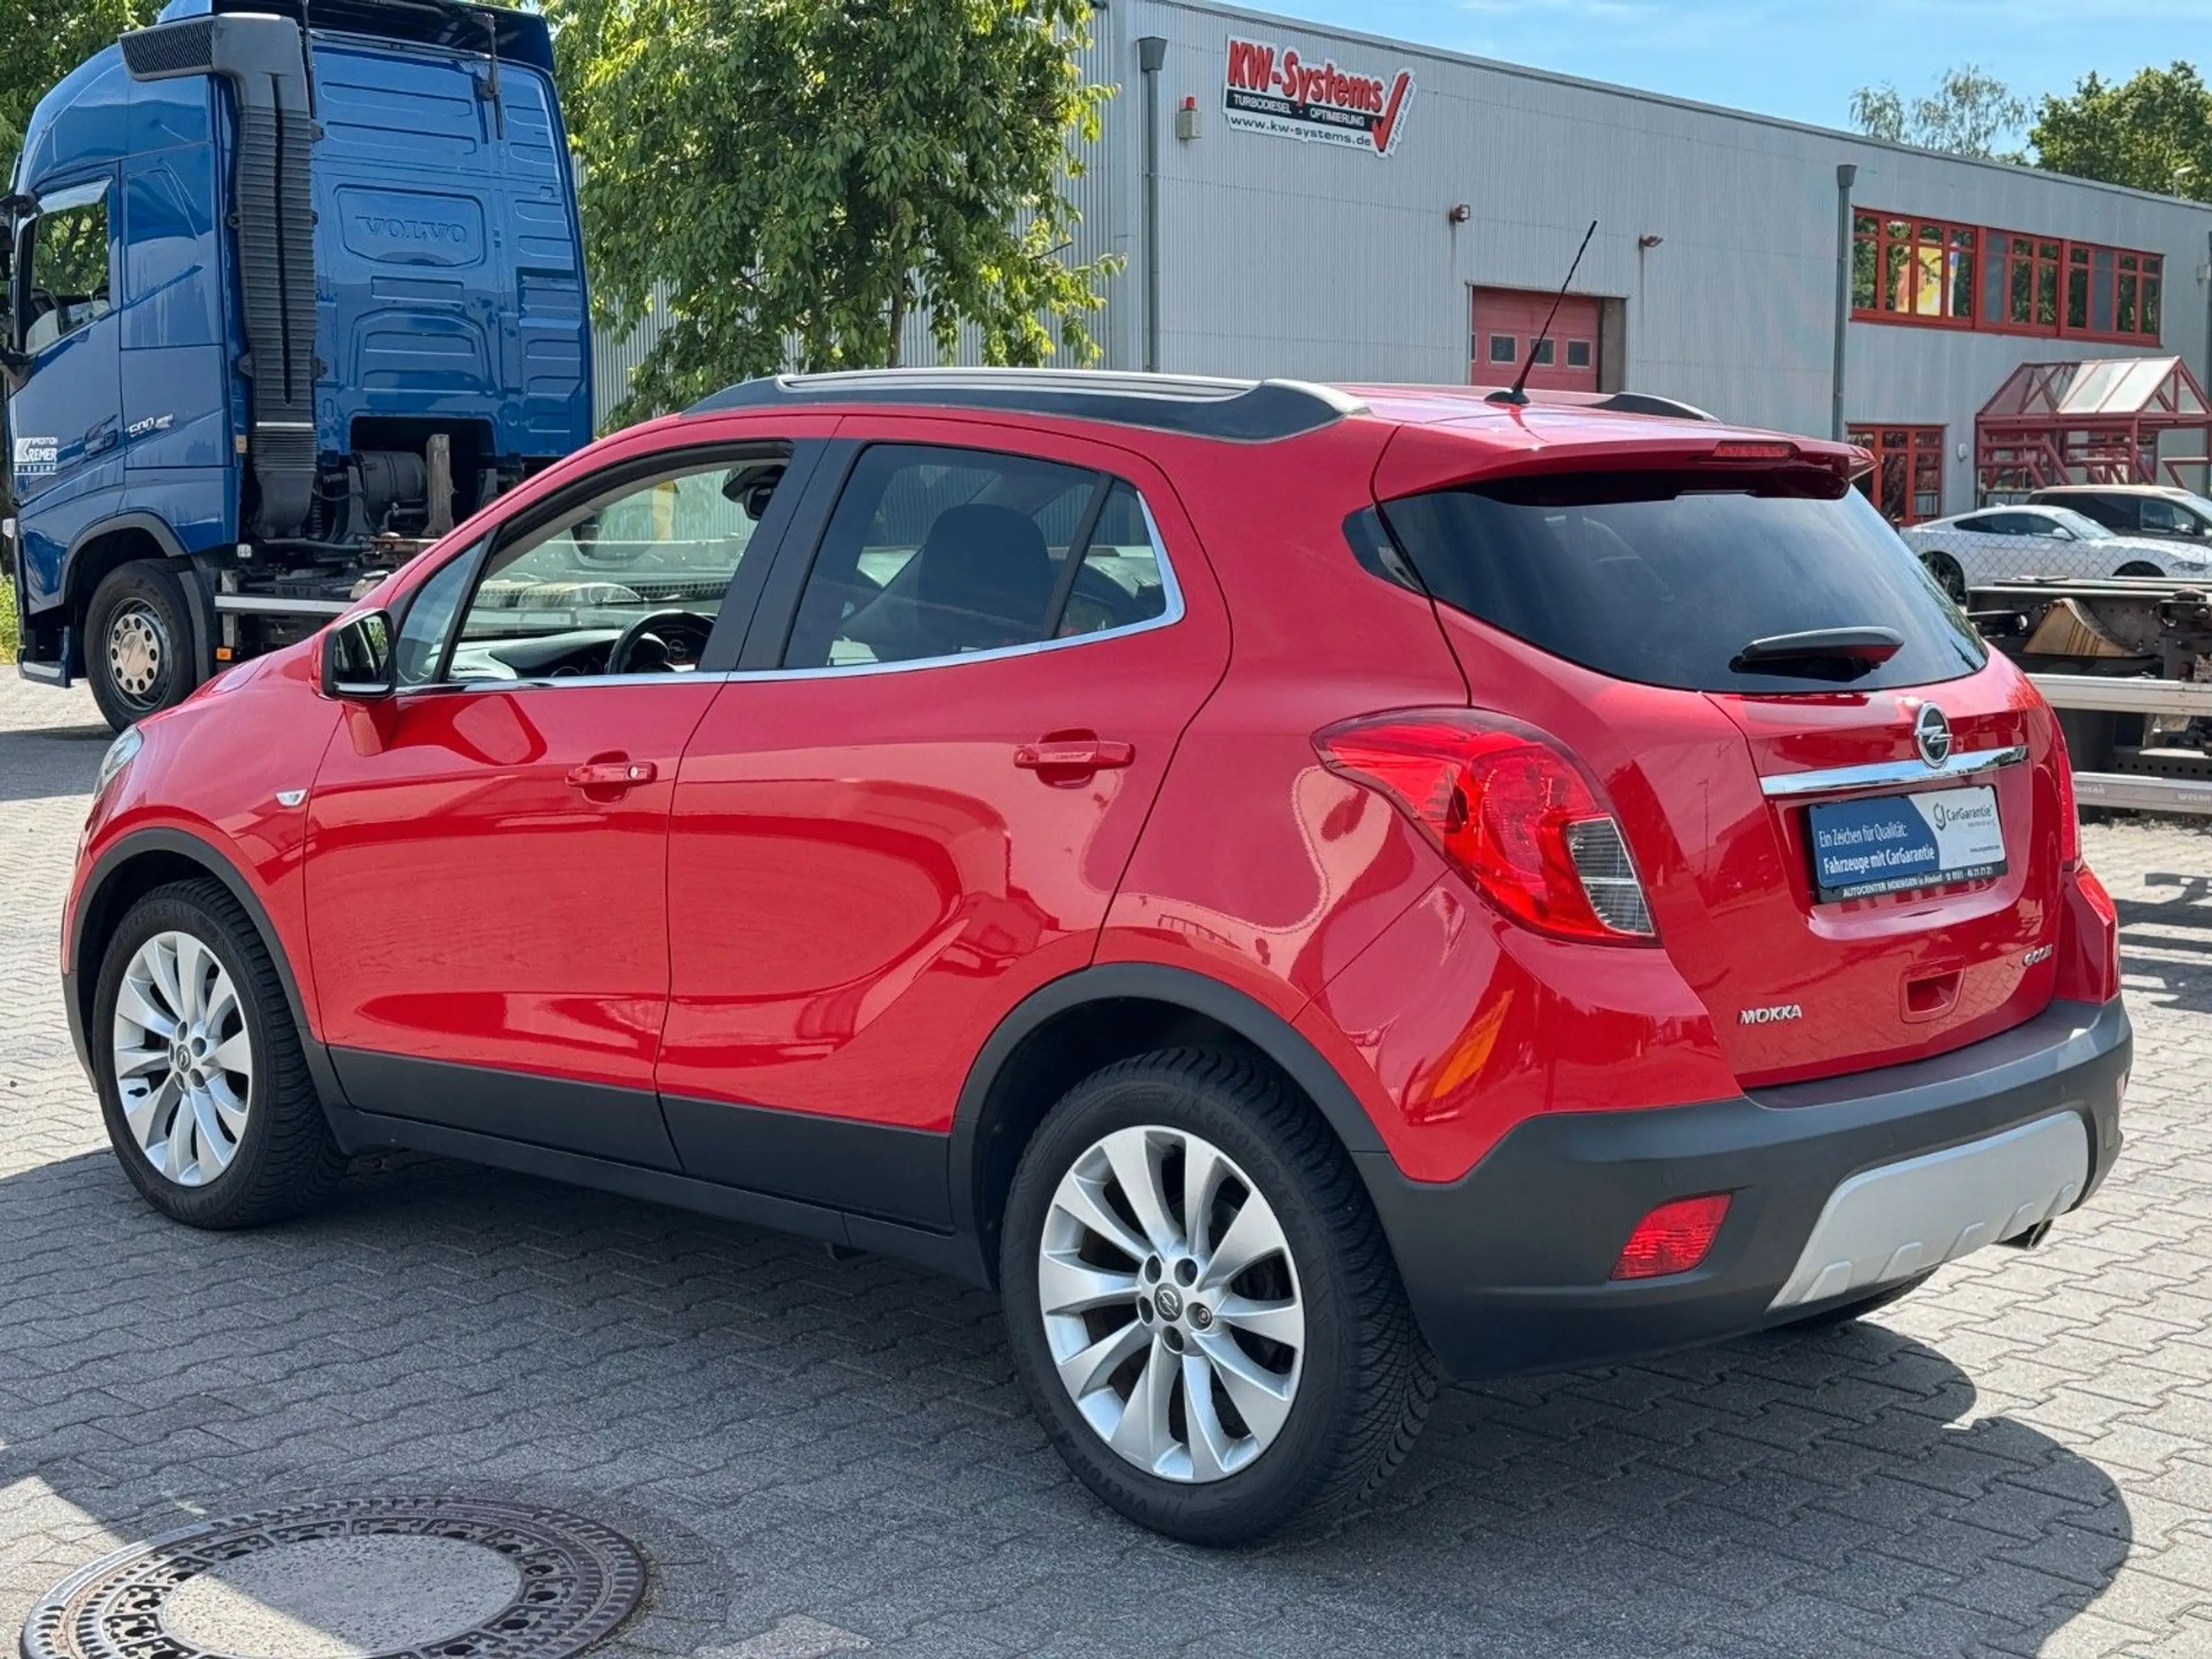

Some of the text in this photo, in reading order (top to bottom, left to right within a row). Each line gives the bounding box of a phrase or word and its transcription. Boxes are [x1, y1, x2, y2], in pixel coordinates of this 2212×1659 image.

[1228, 39, 1382, 113] KW-Systems
[1234, 94, 1365, 126] TURBODIESEL OPTIMIERUNG
[1230, 118, 1371, 146] www.kw-systems.de
[354, 215, 467, 243] VOLVO
[1819, 831, 1832, 848] Ein
[1832, 827, 1863, 846] Zeichen
[1823, 843, 1936, 875] Fahrzeuge mit CarGarantie
[1843, 883, 1887, 897] AUTOCENTER
[1739, 1005, 1802, 1025] MOKKA
